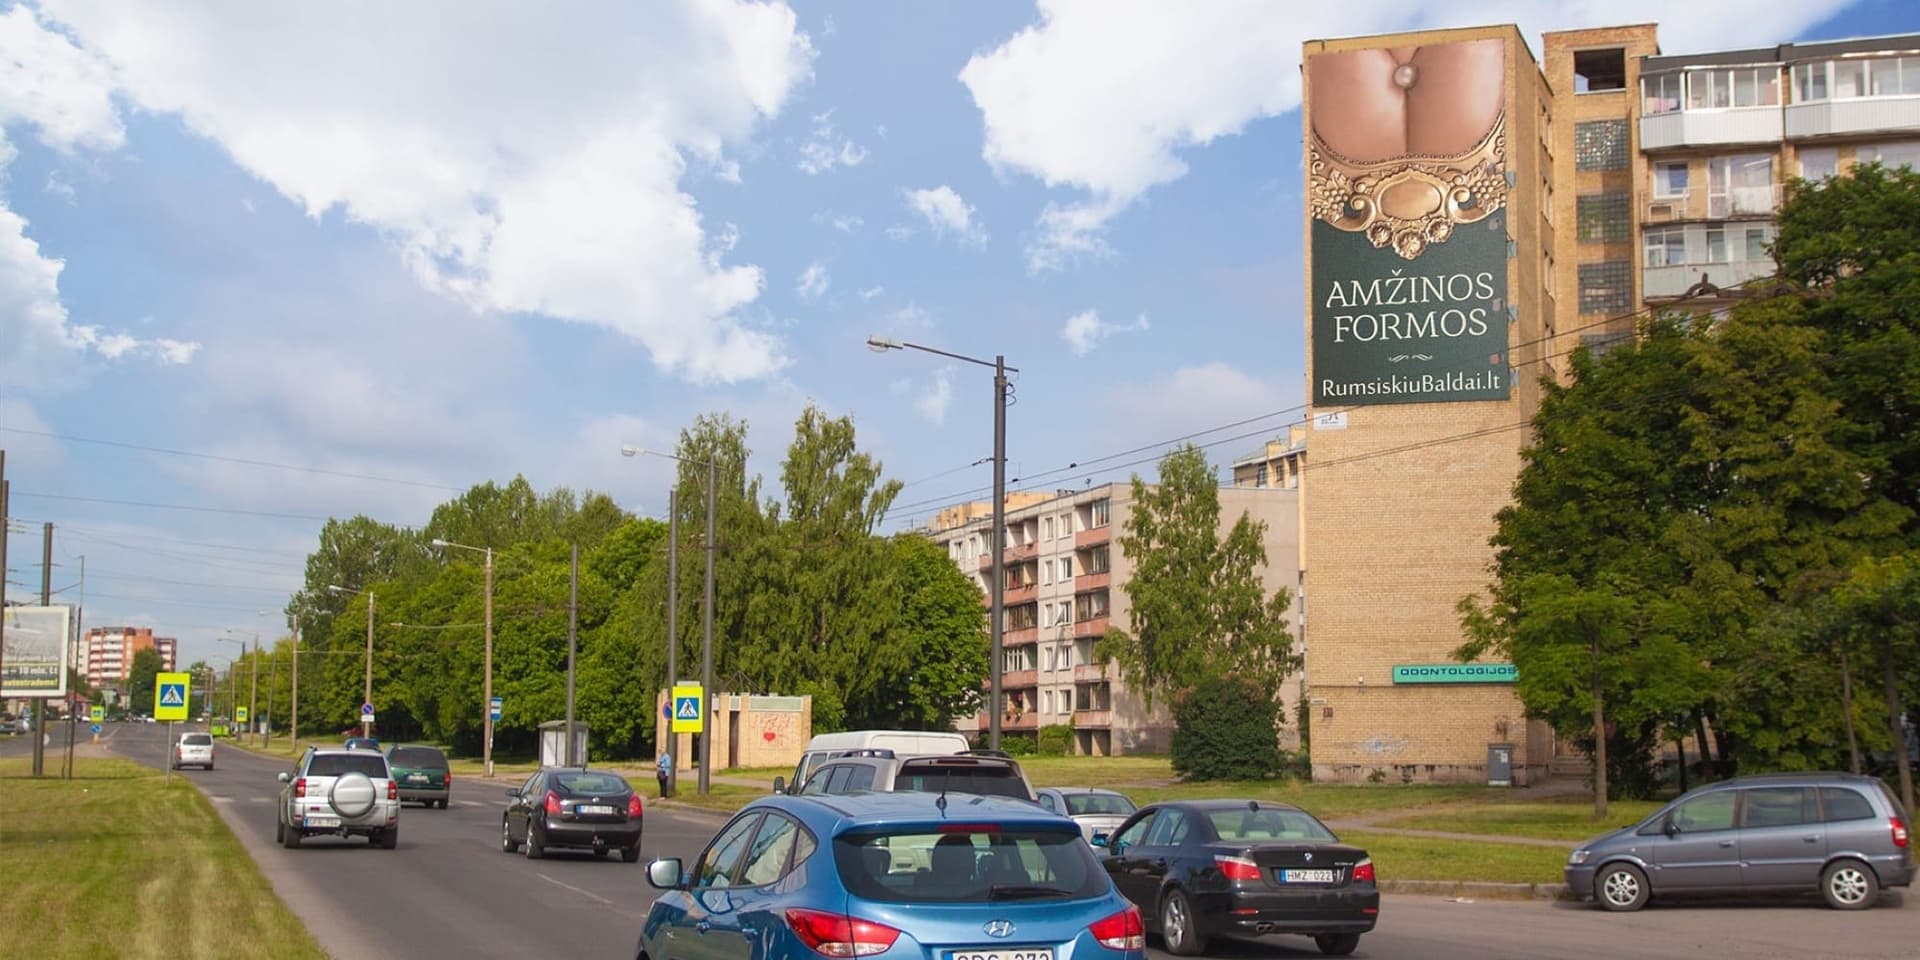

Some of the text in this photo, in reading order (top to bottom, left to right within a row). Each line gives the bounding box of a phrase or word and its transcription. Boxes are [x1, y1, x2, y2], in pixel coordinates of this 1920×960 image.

[1326, 268, 1494, 308] AMŽINOS
[1333, 308, 1488, 343] FORMOS
[1322, 370, 1500, 397] RumsiskiuBaldai.lt
[1287, 871, 1308, 881] HMZ
